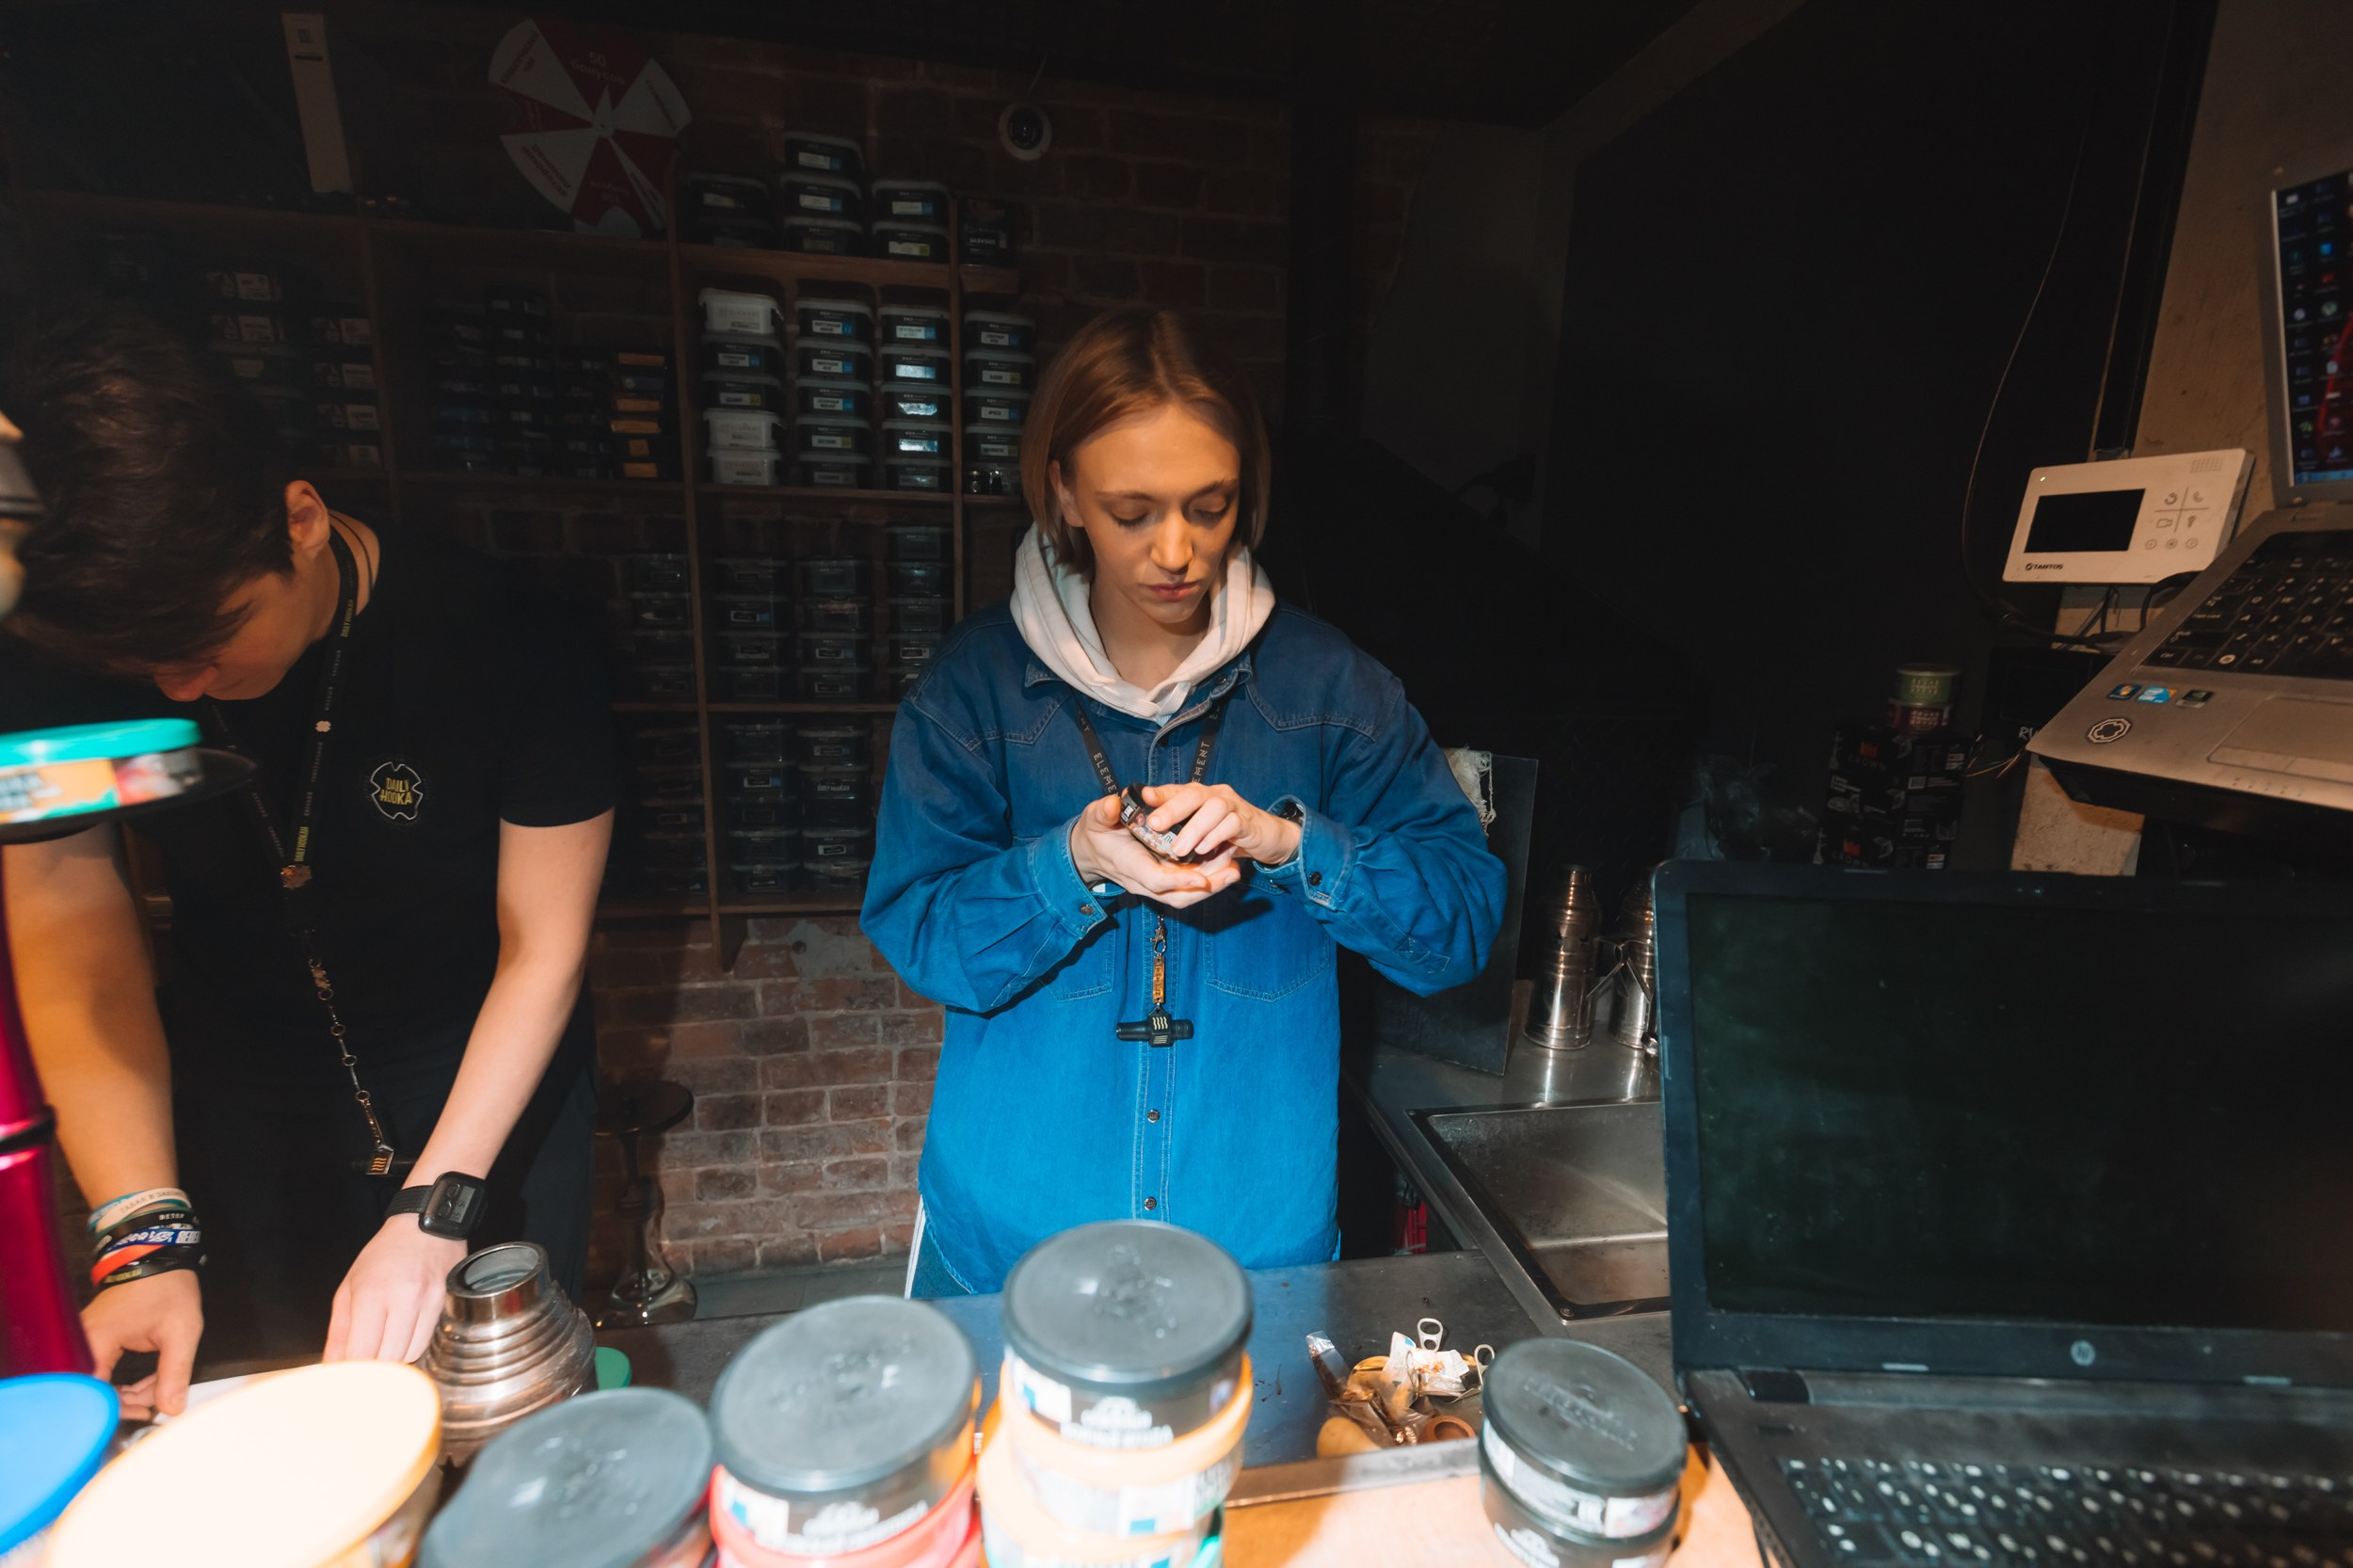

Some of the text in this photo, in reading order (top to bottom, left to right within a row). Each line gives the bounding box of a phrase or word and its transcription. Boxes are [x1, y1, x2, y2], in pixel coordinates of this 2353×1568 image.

[588, 51, 607, 68] 50
[1093, 752, 1119, 793] ELEME
[1192, 741, 1210, 783] EMENT
[386, 777, 410, 792] DAILY
